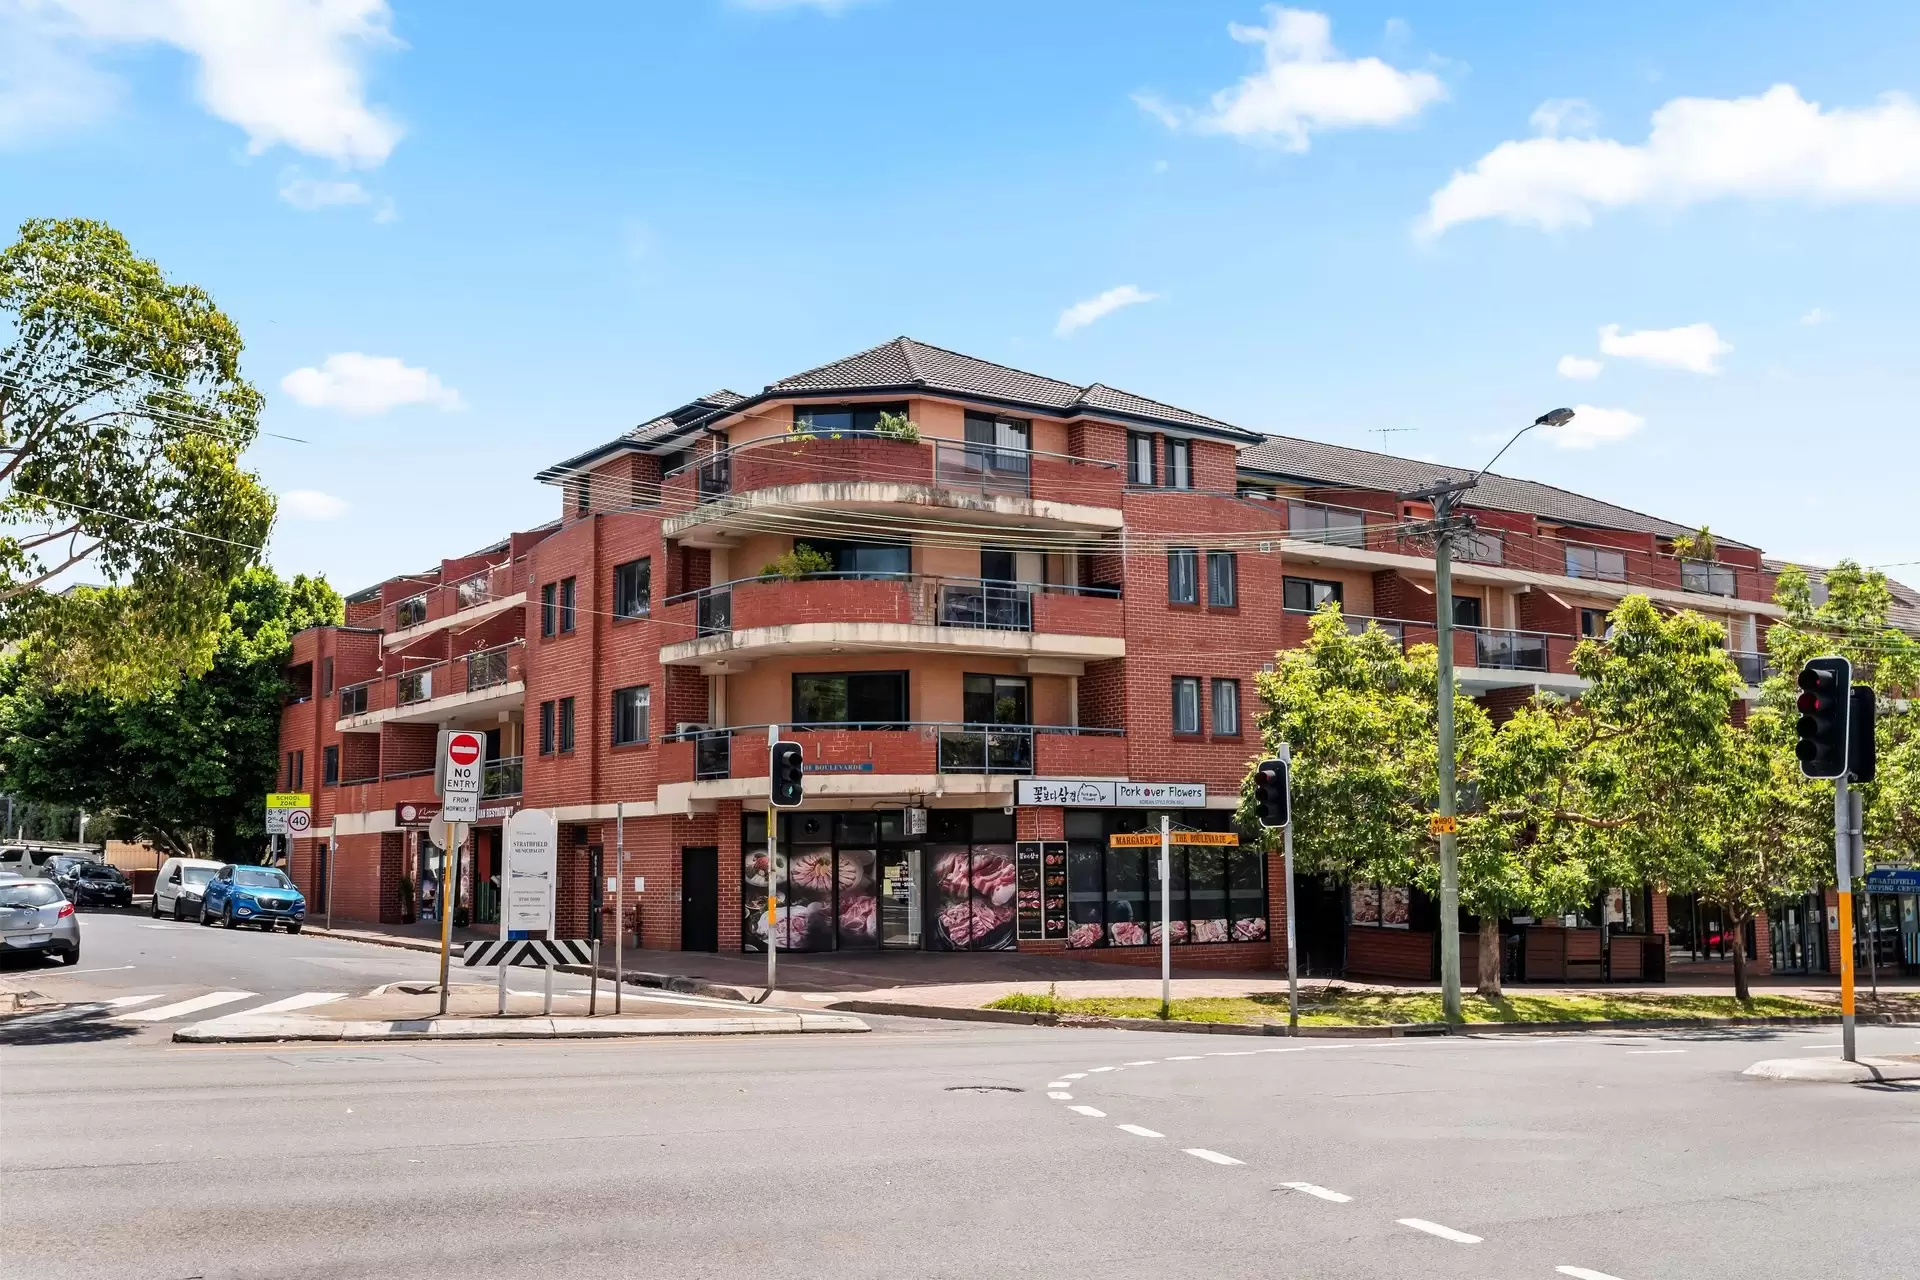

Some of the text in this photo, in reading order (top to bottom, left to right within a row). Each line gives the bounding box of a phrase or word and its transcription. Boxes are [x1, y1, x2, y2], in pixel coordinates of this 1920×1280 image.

[454, 768, 472, 778] NO
[448, 780, 477, 788] ENTRY
[1120, 786, 1140, 797] Pork
[1169, 786, 1202, 798] Flowers
[292, 816, 306, 826] 40
[1116, 836, 1154, 845] MARGARET
[1176, 834, 1186, 842] THE
[1190, 834, 1226, 844] BOULEVARDE
